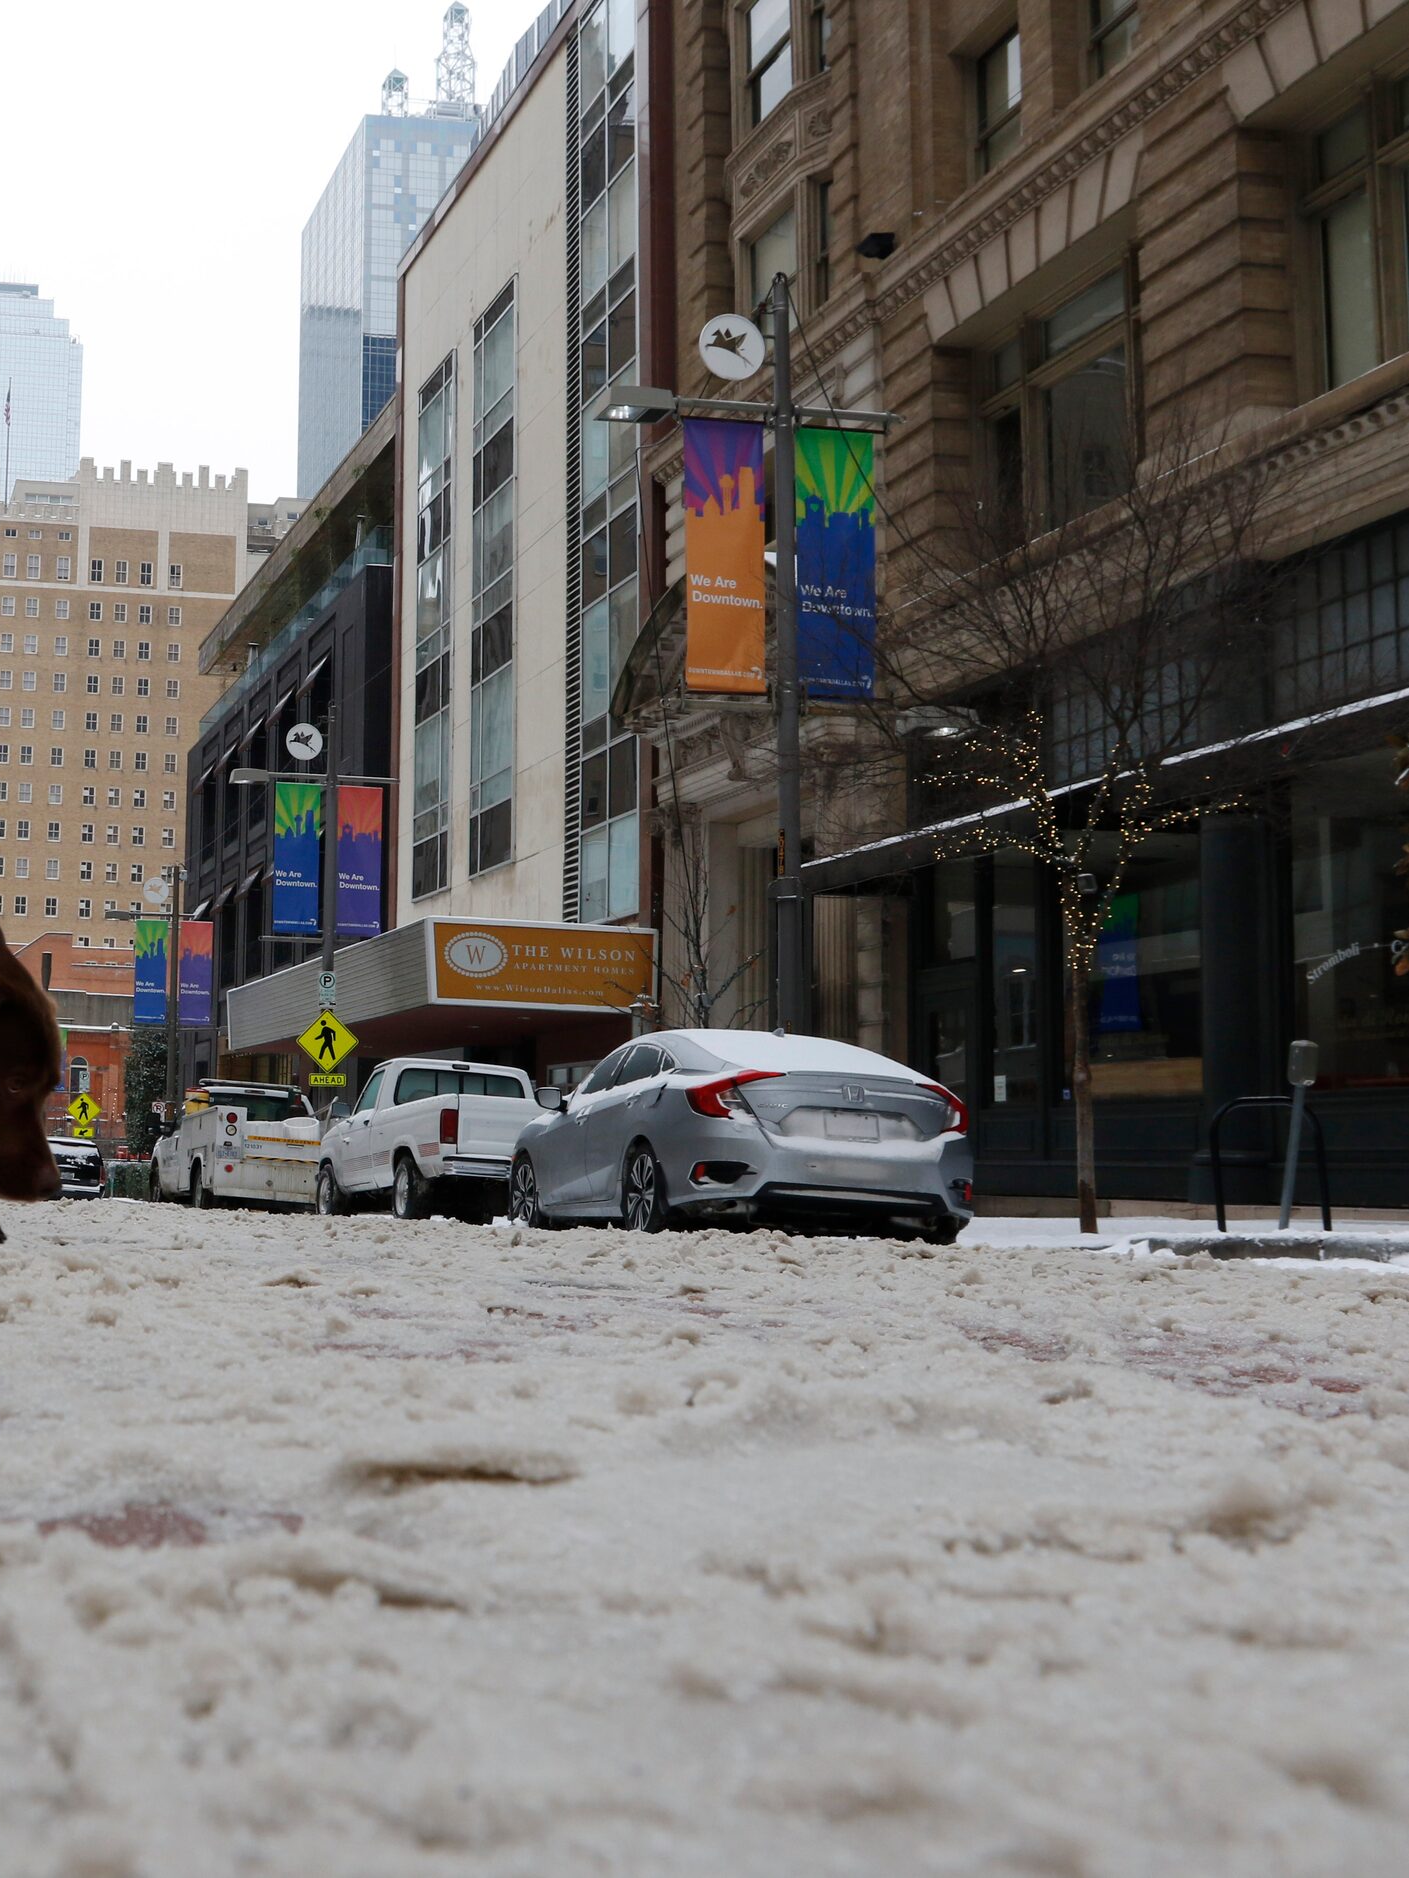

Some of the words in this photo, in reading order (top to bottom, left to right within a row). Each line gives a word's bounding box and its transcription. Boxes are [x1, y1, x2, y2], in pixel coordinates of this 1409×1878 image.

[690, 573, 711, 587] We
[715, 576, 737, 589] Are
[800, 584, 822, 597] We
[824, 585, 848, 599] Are
[692, 590, 763, 609] Downtown.
[801, 601, 874, 618] Downtown.
[275, 869, 288, 878] We
[289, 870, 302, 879] Are
[338, 872, 350, 880] We
[351, 873, 364, 881] Are
[275, 878, 318, 889] Downtown.
[339, 881, 380, 891] Downtown.
[465, 943, 487, 966] W
[511, 944, 550, 958] THE
[561, 947, 636, 961] WILSON
[513, 961, 588, 974] APARTMENT
[593, 965, 635, 976] HOMES
[1305, 941, 1361, 985] Stromboli
[323, 976, 332, 986] P
[475, 983, 604, 997] www.WilsonDallas.com
[313, 1076, 343, 1084] AHEAD
